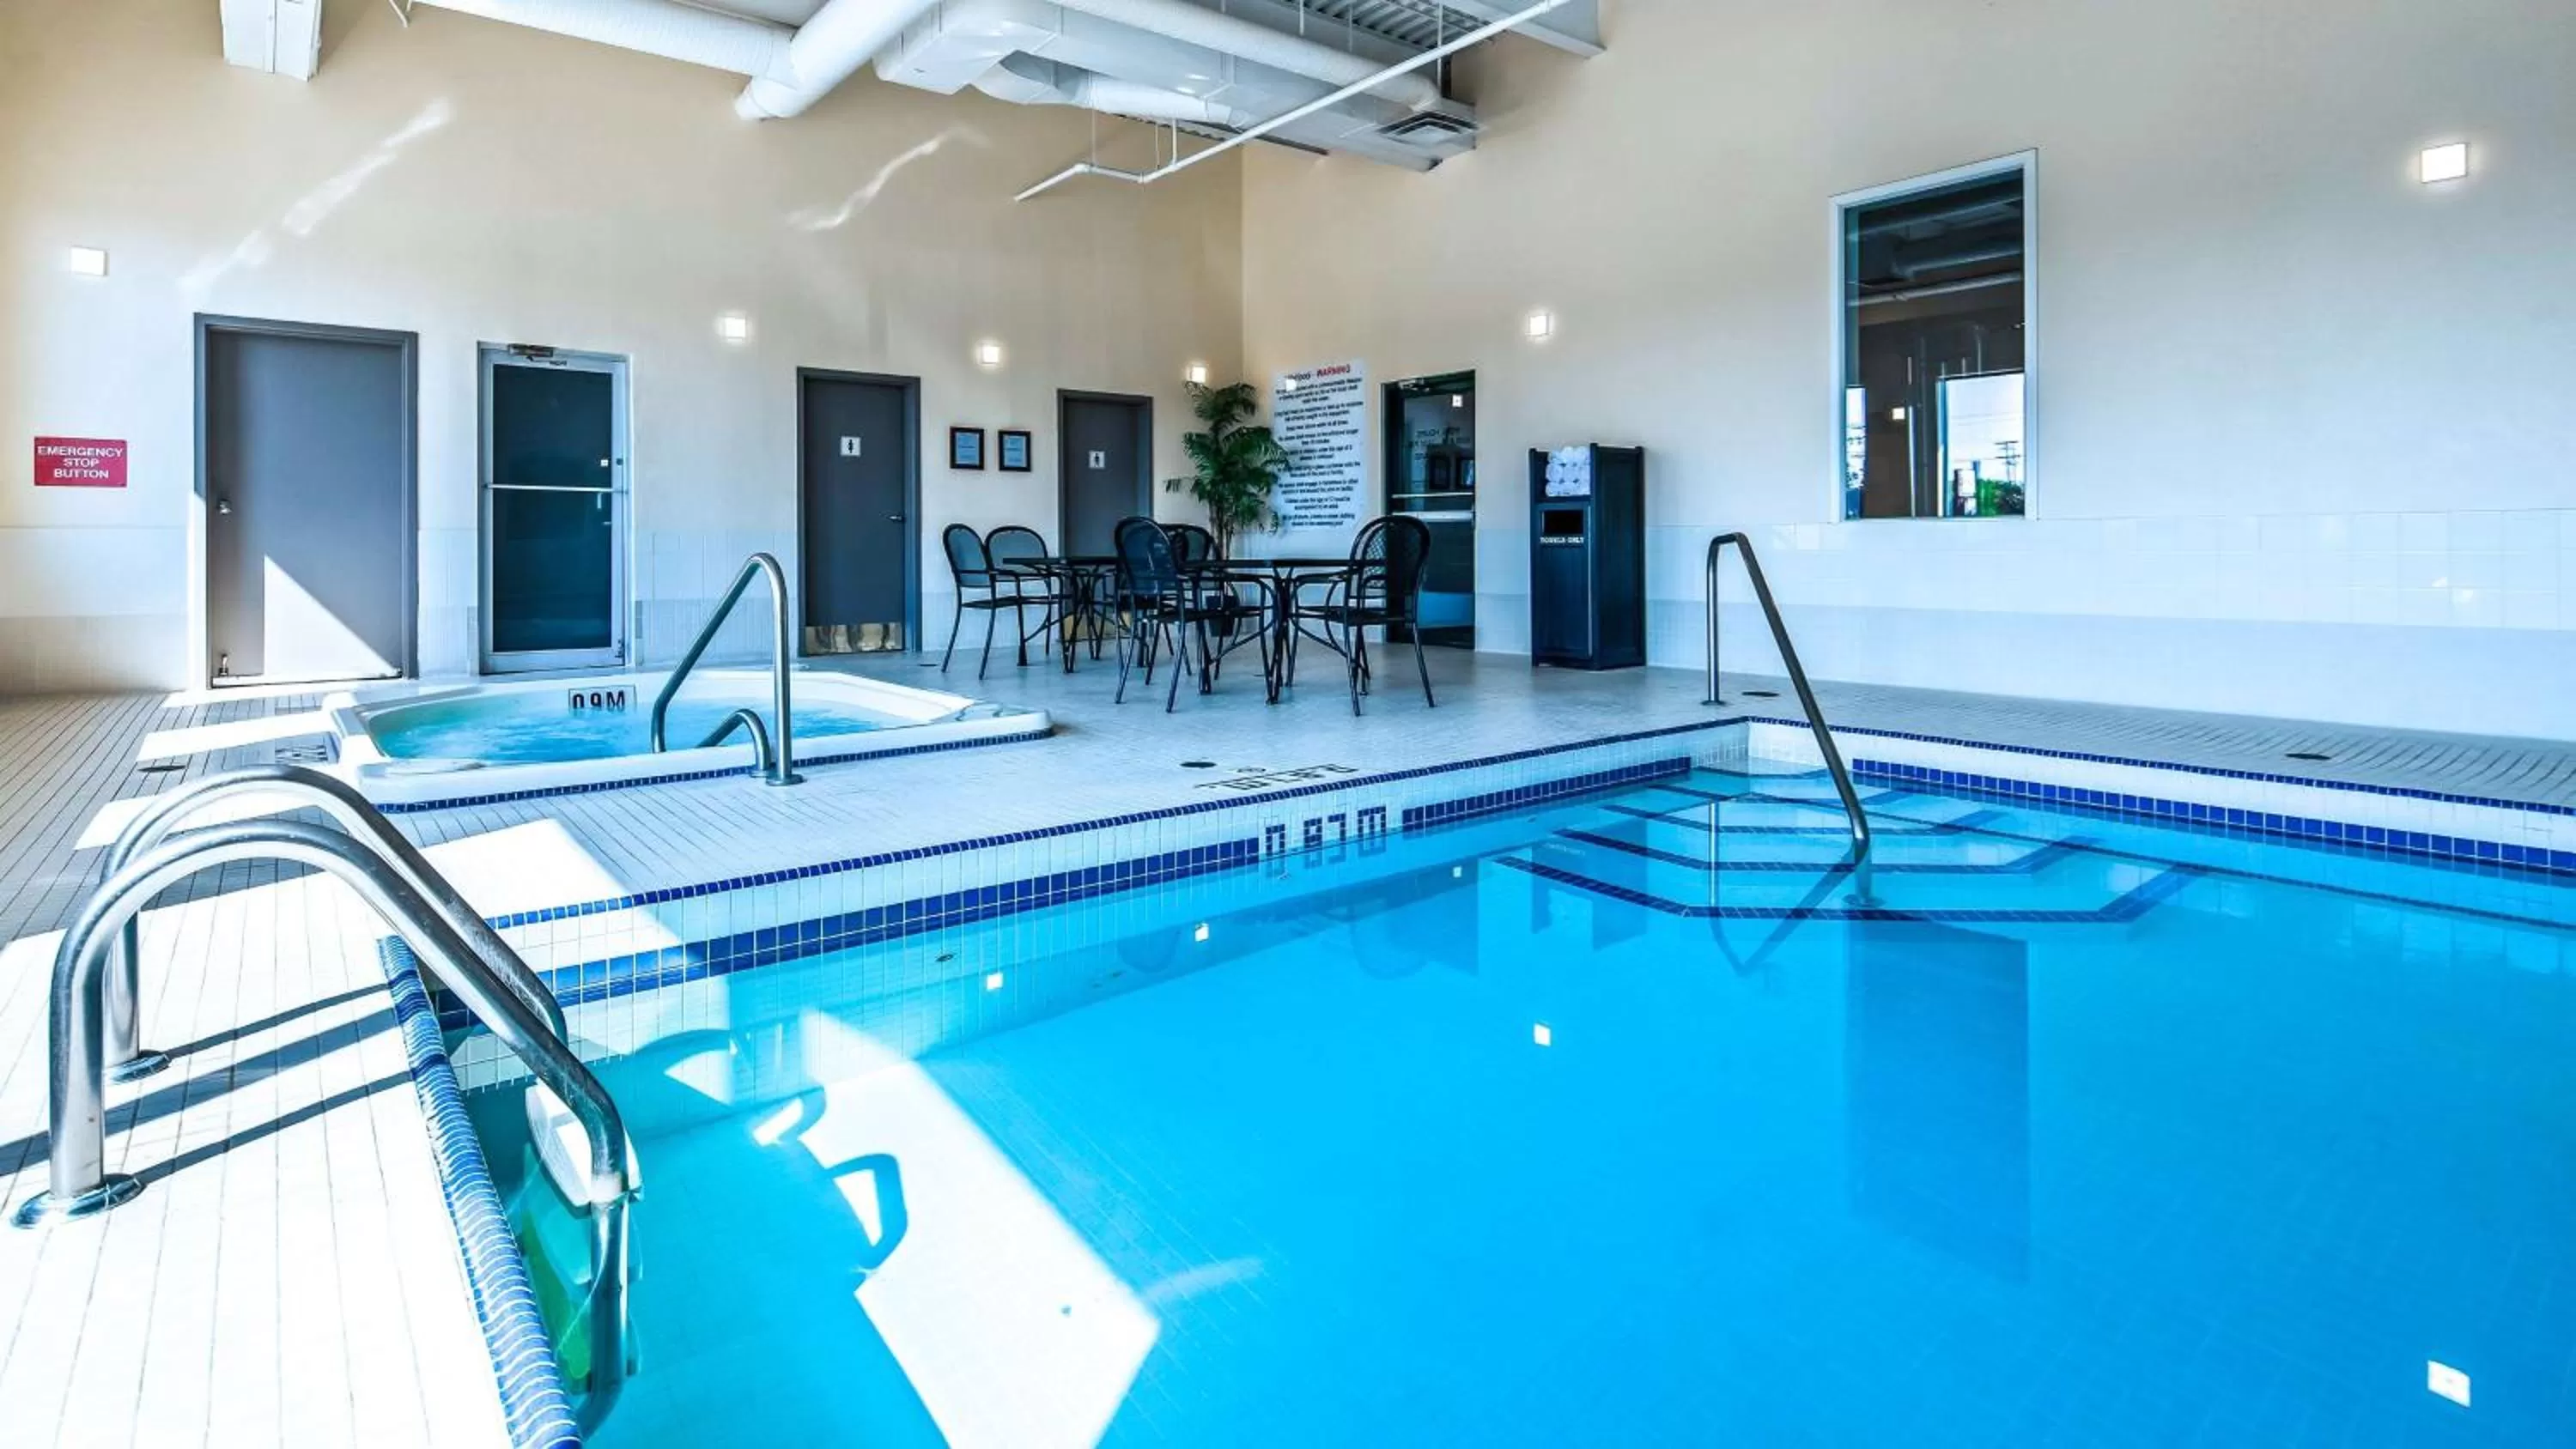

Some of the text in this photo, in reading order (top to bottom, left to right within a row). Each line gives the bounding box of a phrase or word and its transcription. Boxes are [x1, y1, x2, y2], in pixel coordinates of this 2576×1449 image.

[37, 446, 123, 458] EMERGENCY
[63, 458, 100, 467] STOP
[53, 468, 109, 479] BUTTON
